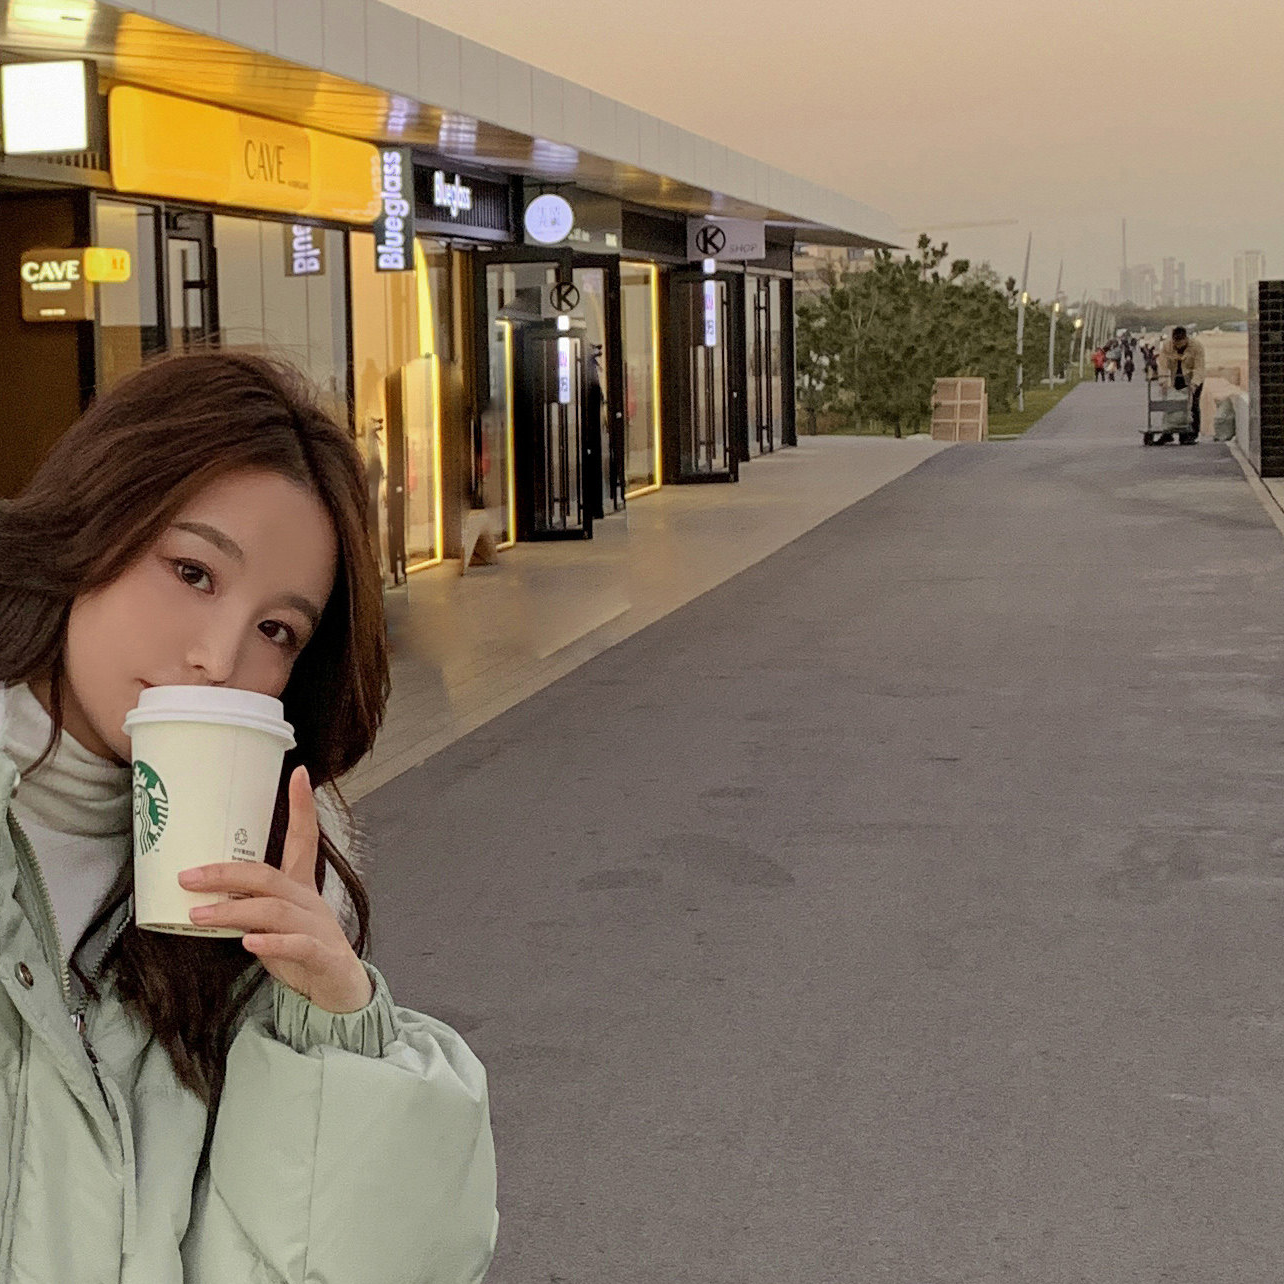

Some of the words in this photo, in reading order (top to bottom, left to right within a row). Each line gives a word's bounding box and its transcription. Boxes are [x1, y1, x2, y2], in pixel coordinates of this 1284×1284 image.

[244, 139, 286, 184] CAVE
[377, 151, 410, 270] Blueglass
[20, 259, 80, 283] CAVE
